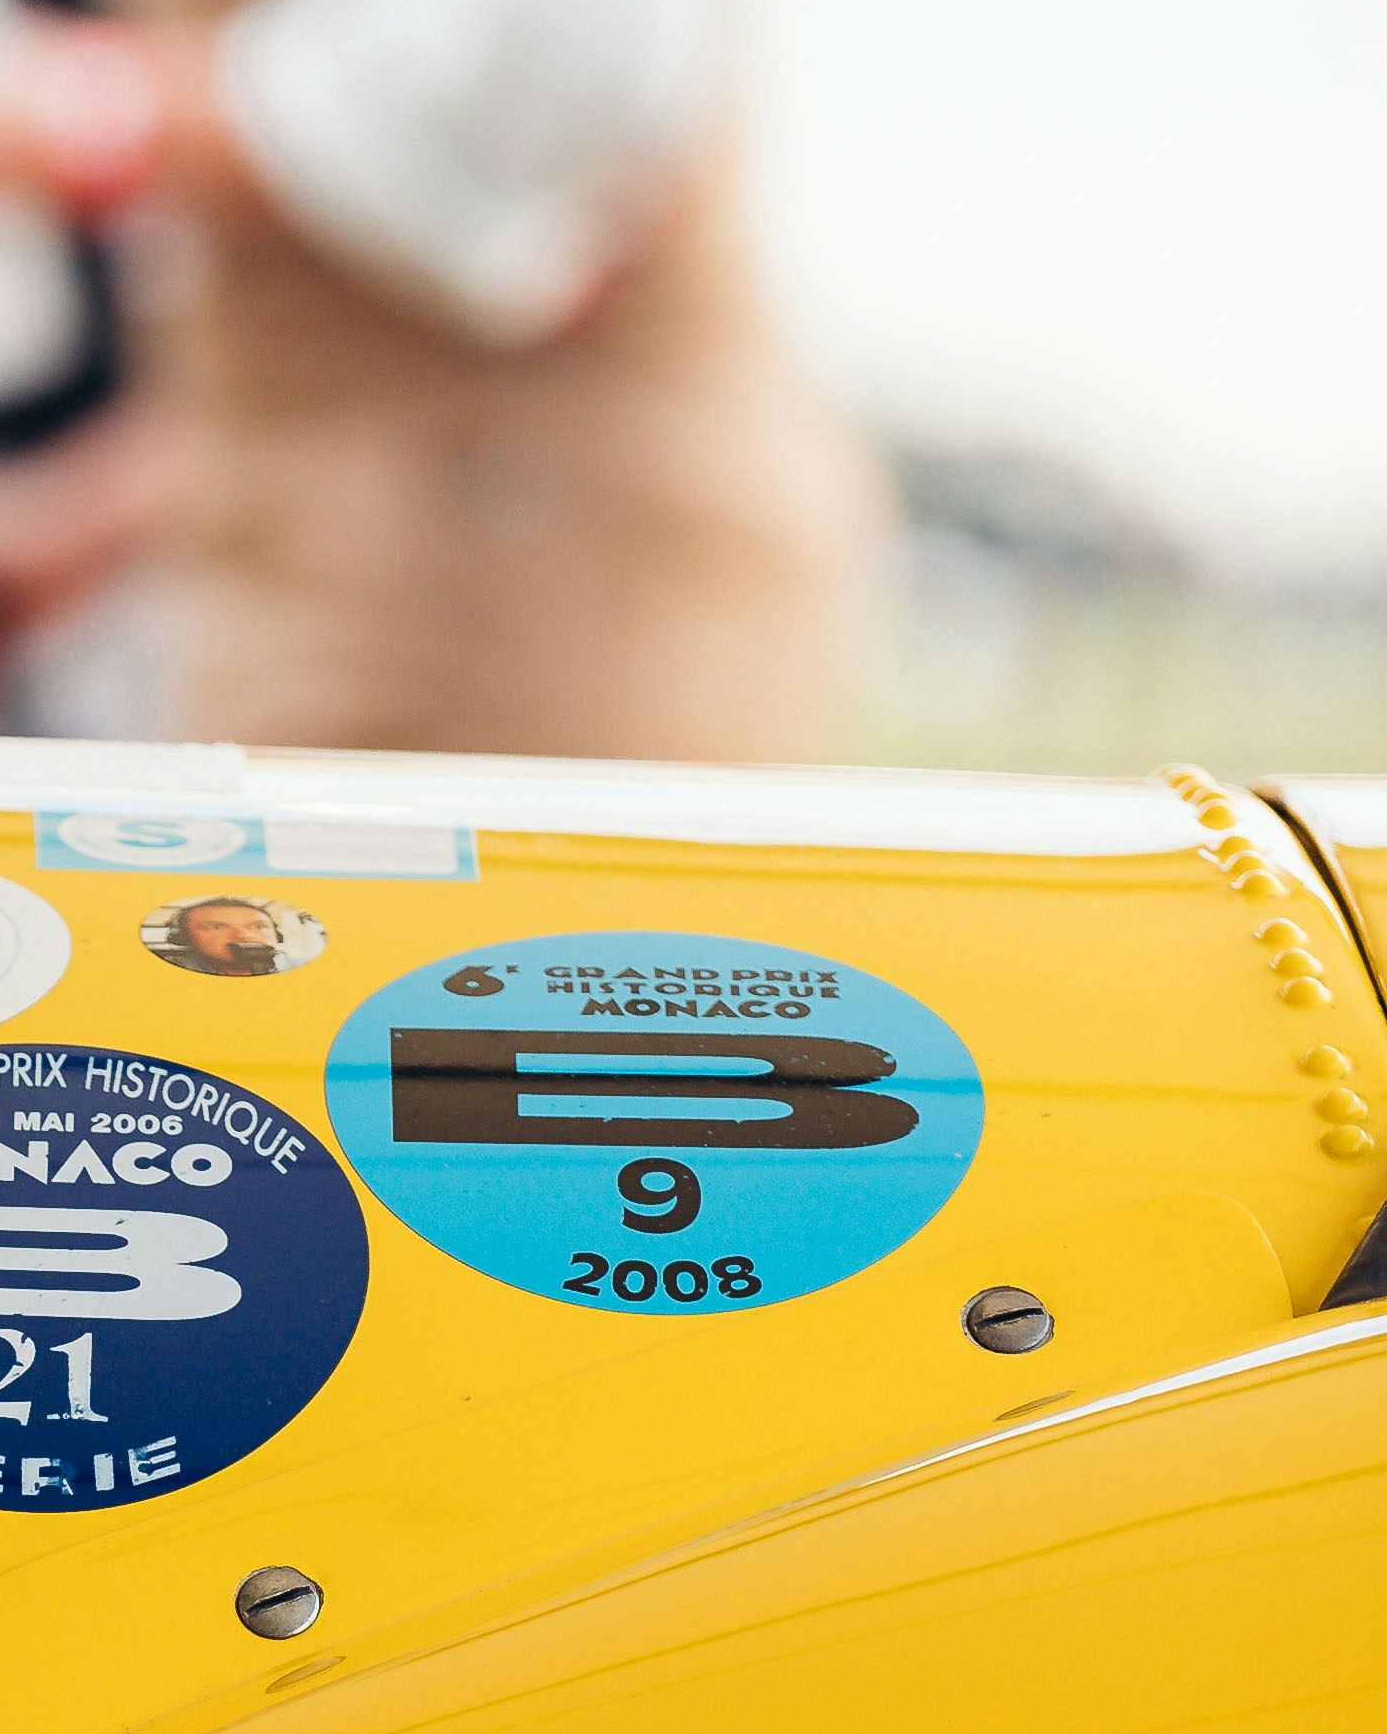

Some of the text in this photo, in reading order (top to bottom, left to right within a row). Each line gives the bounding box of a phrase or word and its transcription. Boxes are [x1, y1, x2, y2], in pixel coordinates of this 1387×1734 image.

[545, 966, 838, 984] GRAND PRIX
[546, 980, 841, 1000] HISTORIQUE
[582, 998, 812, 1021] MONACO
[390, 1027, 920, 1150] B
[12, 1110, 75, 1133] MAI
[90, 1112, 184, 1136] 2006
[84, 1055, 307, 1175] HISTORIQUE
[615, 1158, 703, 1235] 9
[561, 1251, 763, 1303] 2008
